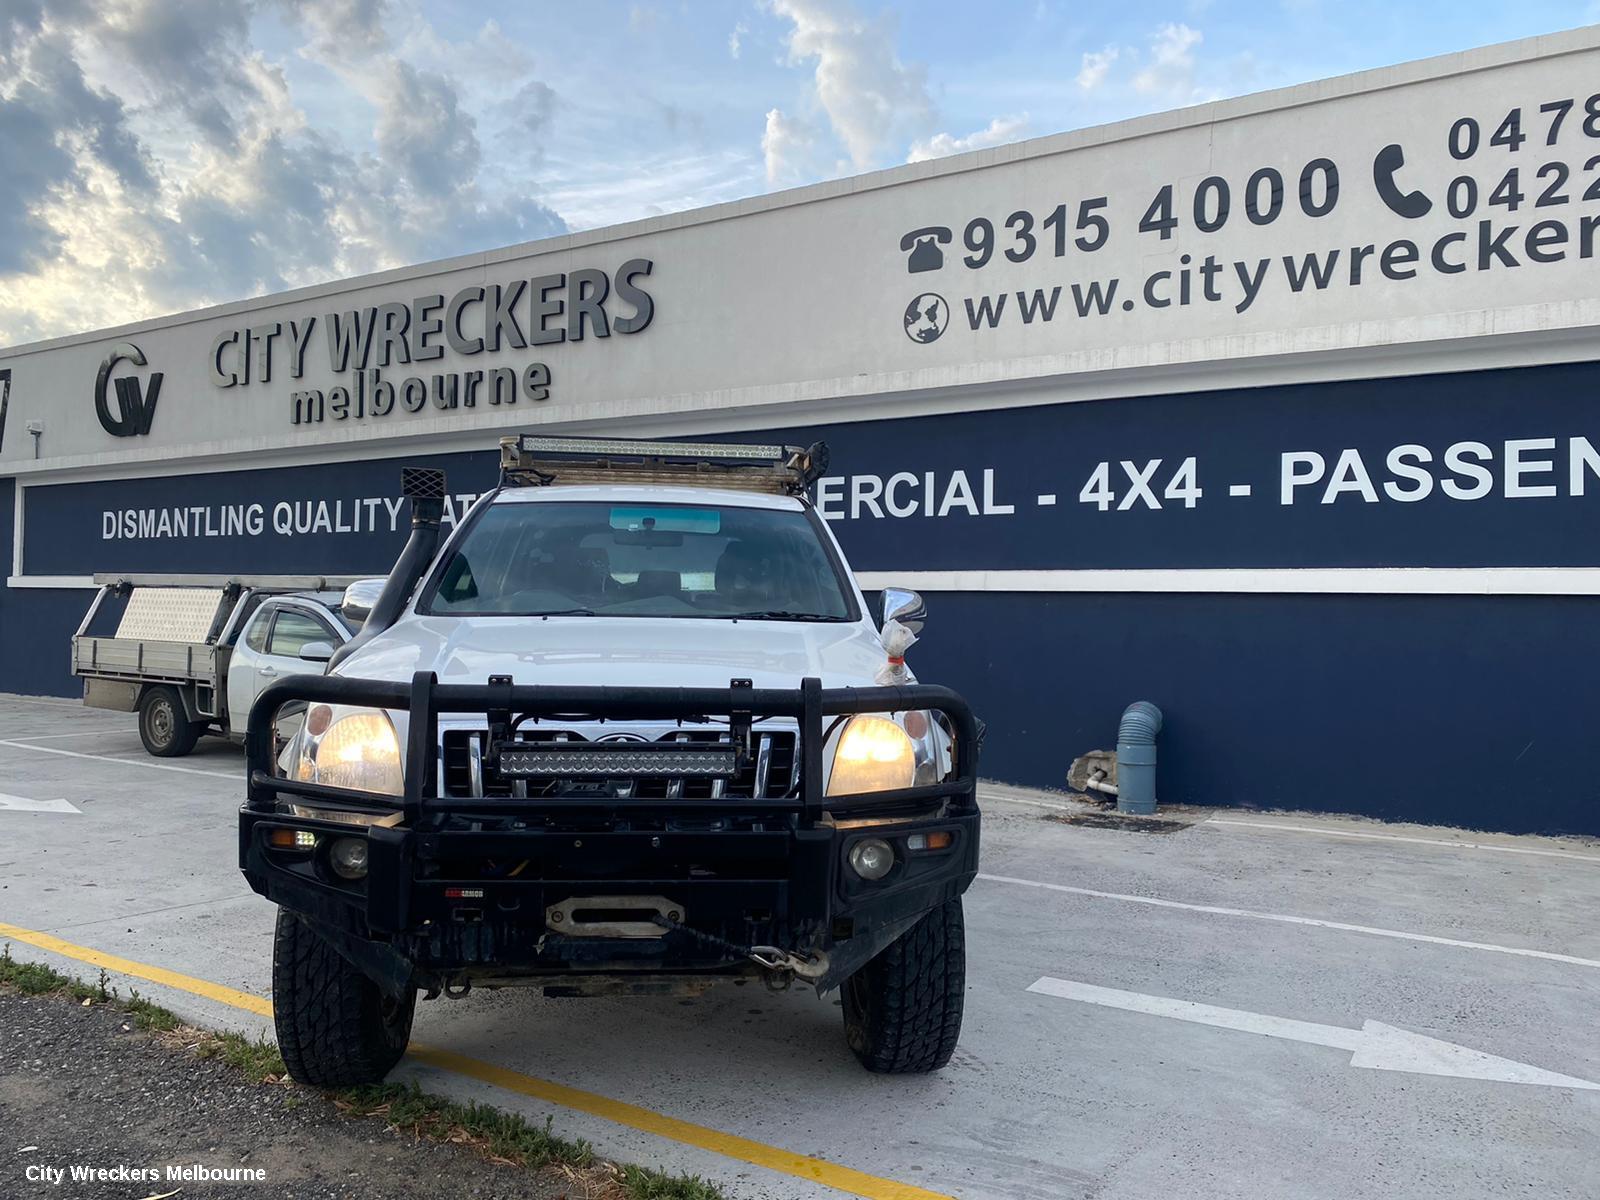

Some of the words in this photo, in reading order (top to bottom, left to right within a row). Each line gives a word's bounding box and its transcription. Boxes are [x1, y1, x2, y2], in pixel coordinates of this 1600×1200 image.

[1448, 93, 1600, 160] 0478
[963, 197, 1109, 270] 9315
[1139, 157, 1340, 241] 4000
[1447, 155, 1600, 219] 0422
[208, 316, 317, 388] CITY
[325, 258, 656, 373] WRECKERS
[964, 214, 1600, 331] www.citywrecker
[290, 362, 552, 425] melbourne
[102, 503, 264, 540] DISMANTLING
[273, 497, 405, 537] QUALITY
[816, 469, 1015, 520] ERCIAL
[1079, 457, 1203, 511] 4X4
[1280, 436, 1600, 506] PASSEN
